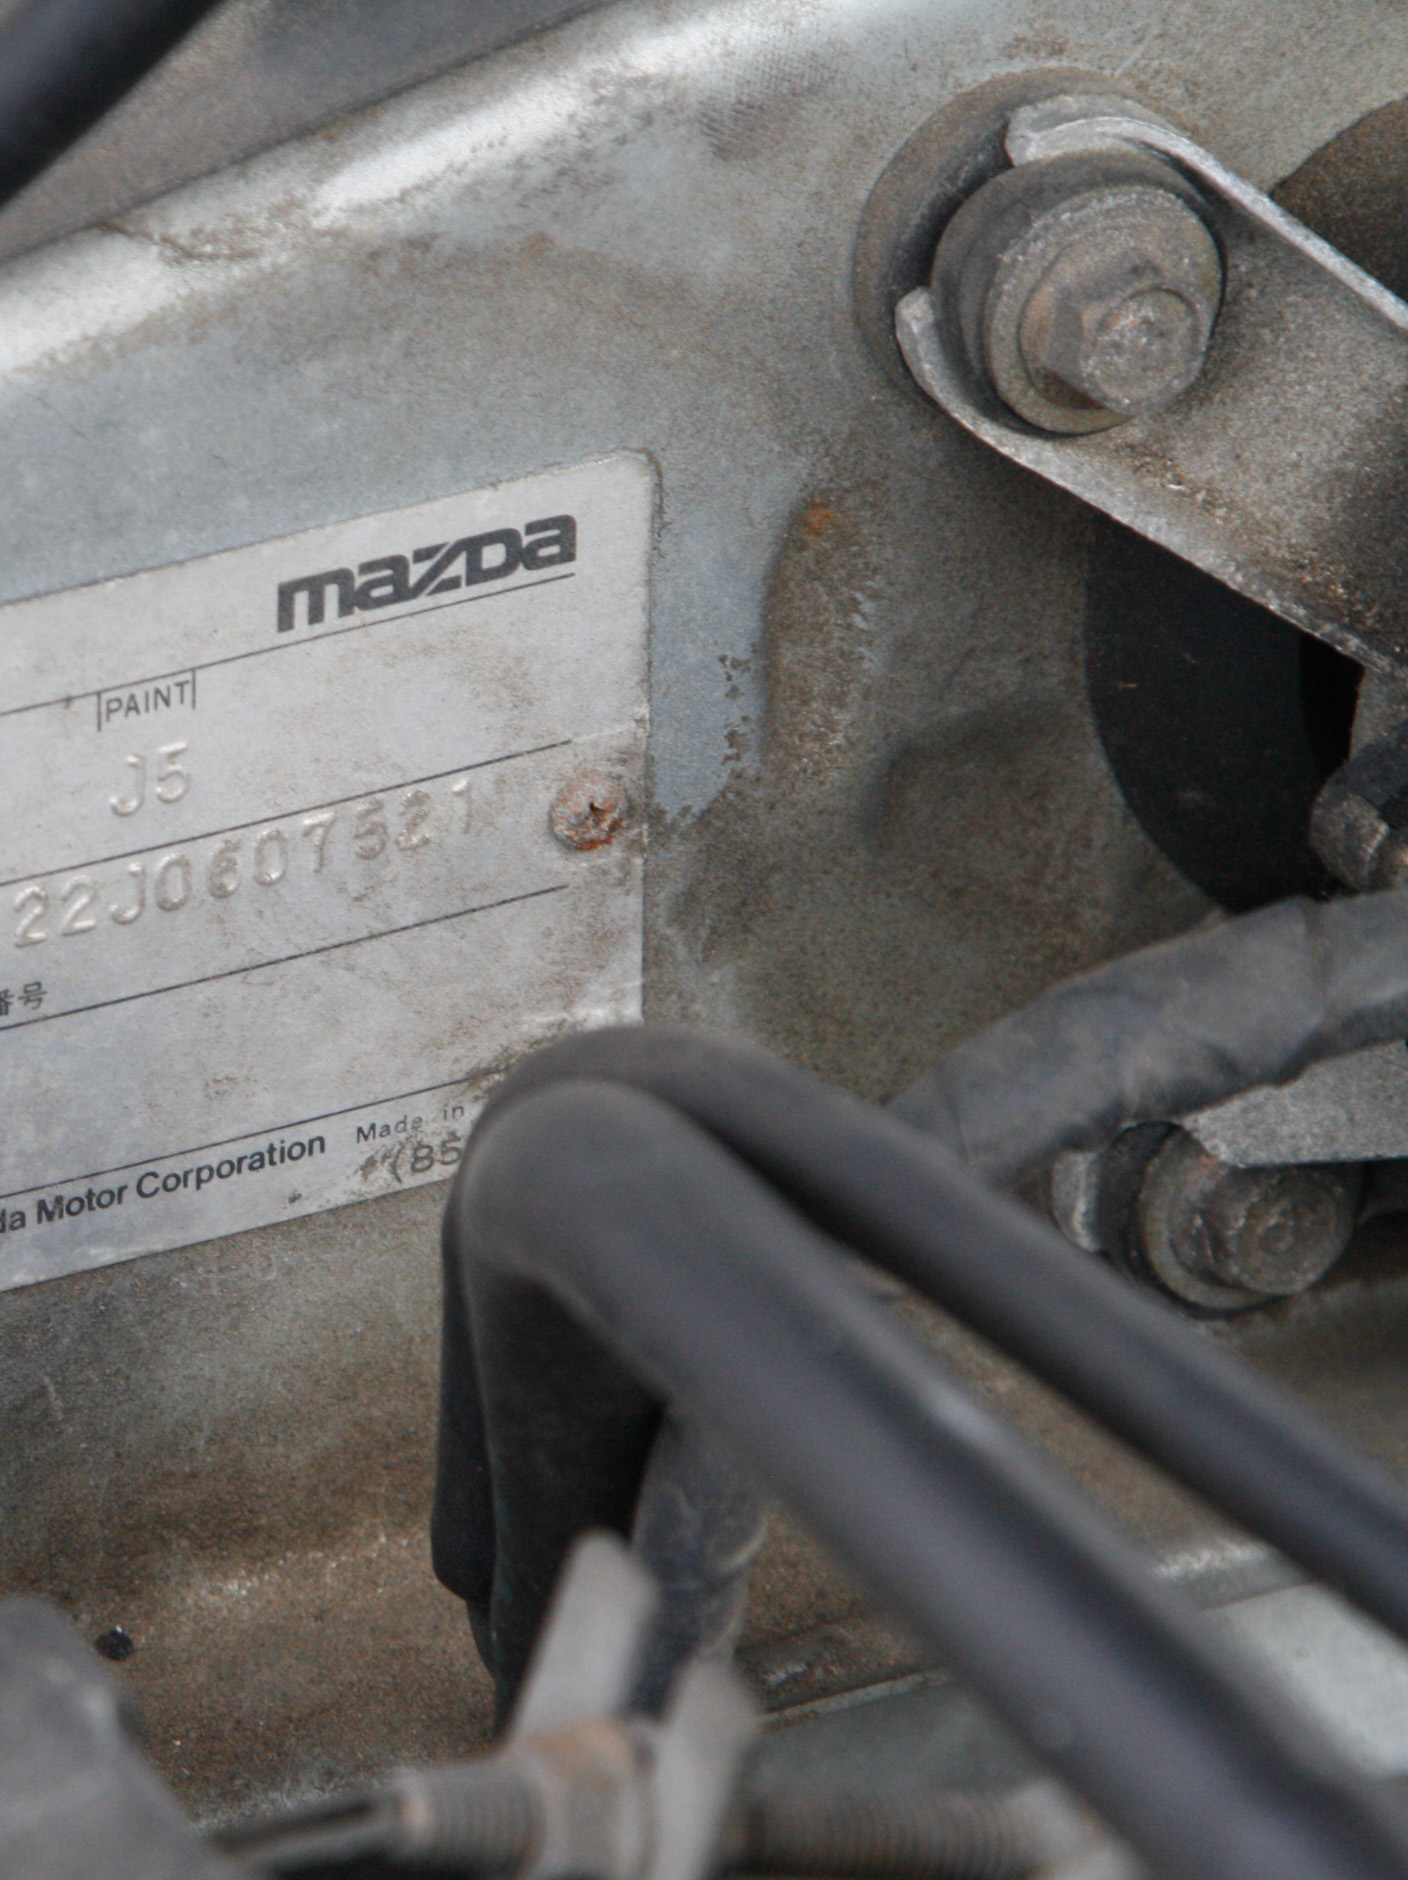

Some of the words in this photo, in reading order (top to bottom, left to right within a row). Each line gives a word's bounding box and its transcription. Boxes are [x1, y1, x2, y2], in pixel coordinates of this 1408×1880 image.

[105, 679, 191, 724] PAINT
[109, 740, 192, 818] J5
[356, 1115, 423, 1143] Made
[442, 1103, 465, 1121] in
[36, 1181, 128, 1226] Motor
[136, 1132, 327, 1200] Corporation
